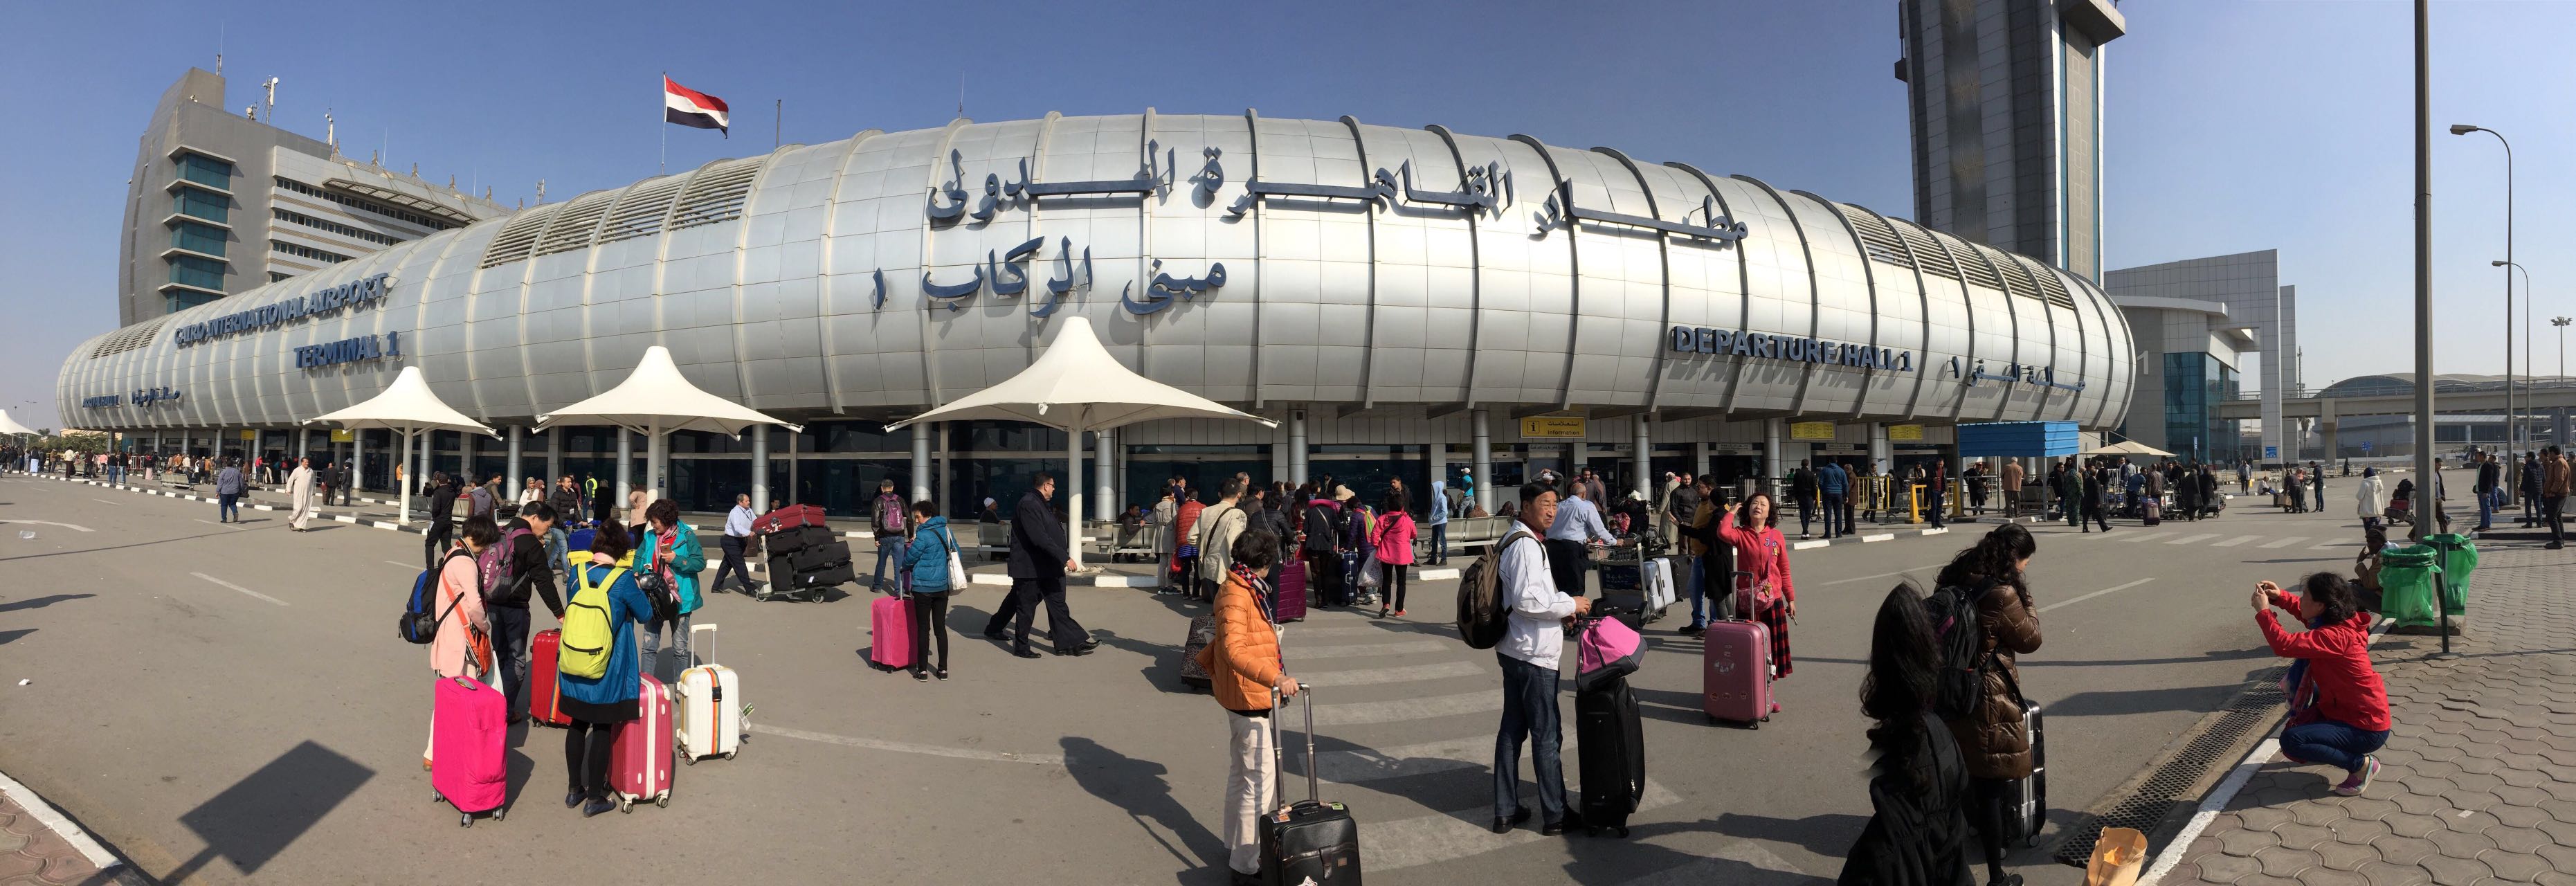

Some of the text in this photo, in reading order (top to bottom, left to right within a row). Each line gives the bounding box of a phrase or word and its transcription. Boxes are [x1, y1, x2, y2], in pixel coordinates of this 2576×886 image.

[1536, 177, 1748, 240] مطار
[174, 272, 388, 344] CAIRO INTERNATIONAL AIRPORT
[923, 236, 1092, 317] الركاب
[294, 331, 400, 368] TERMINAL 1
[1674, 325, 1914, 372] DEPARTURE HALL 1
